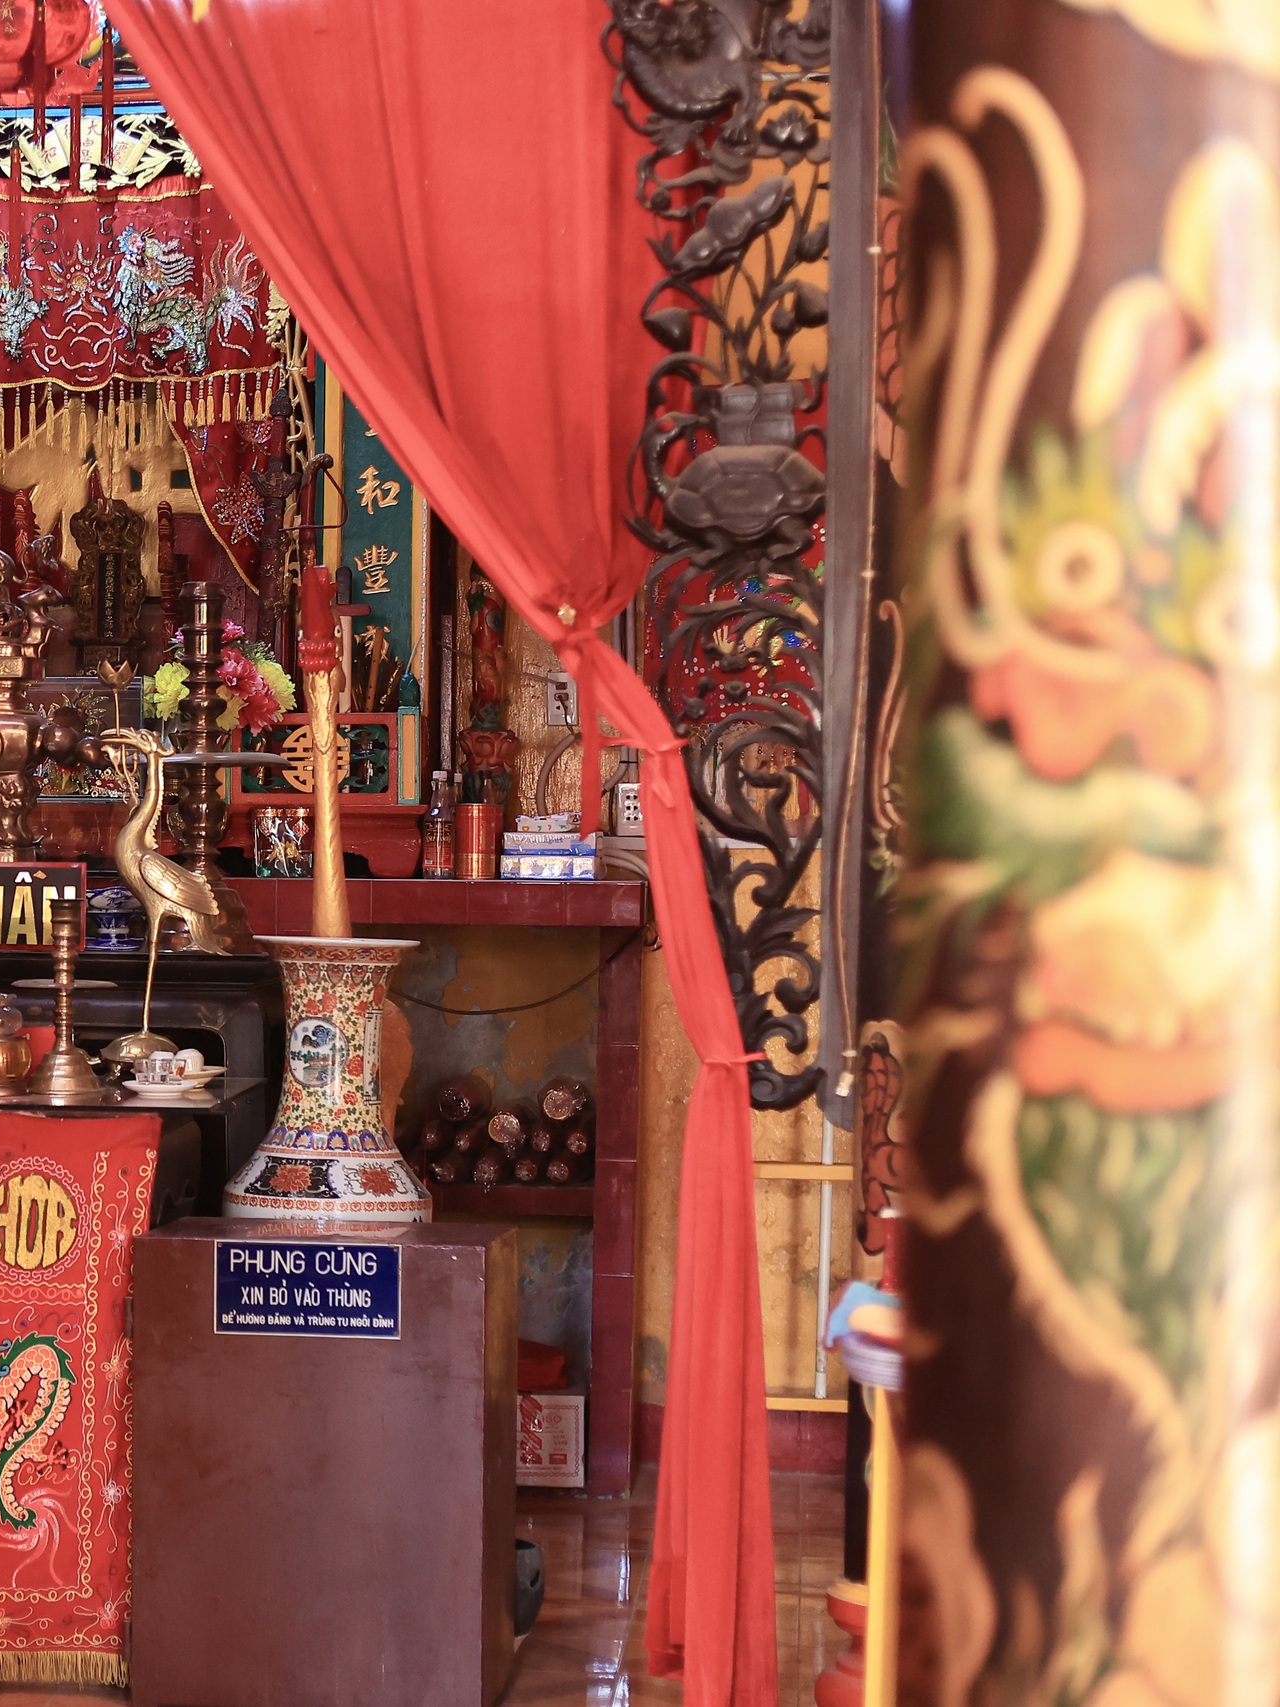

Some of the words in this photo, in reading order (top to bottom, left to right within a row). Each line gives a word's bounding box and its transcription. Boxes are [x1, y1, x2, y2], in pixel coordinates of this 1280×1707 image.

[230, 1248, 306, 1278] PHỤNG
[241, 1286, 264, 1305] XIN
[269, 1279, 288, 1306] BỎ
[294, 1282, 320, 1307] VÀO
[326, 1282, 371, 1308] THÙNG
[222, 1309, 237, 1324] ĐỂ
[293, 1312, 305, 1326] VÀ
[307, 1313, 336, 1327] TRÙNG
[337, 1315, 348, 1327] TU
[373, 1313, 394, 1329] ĐÌNH
